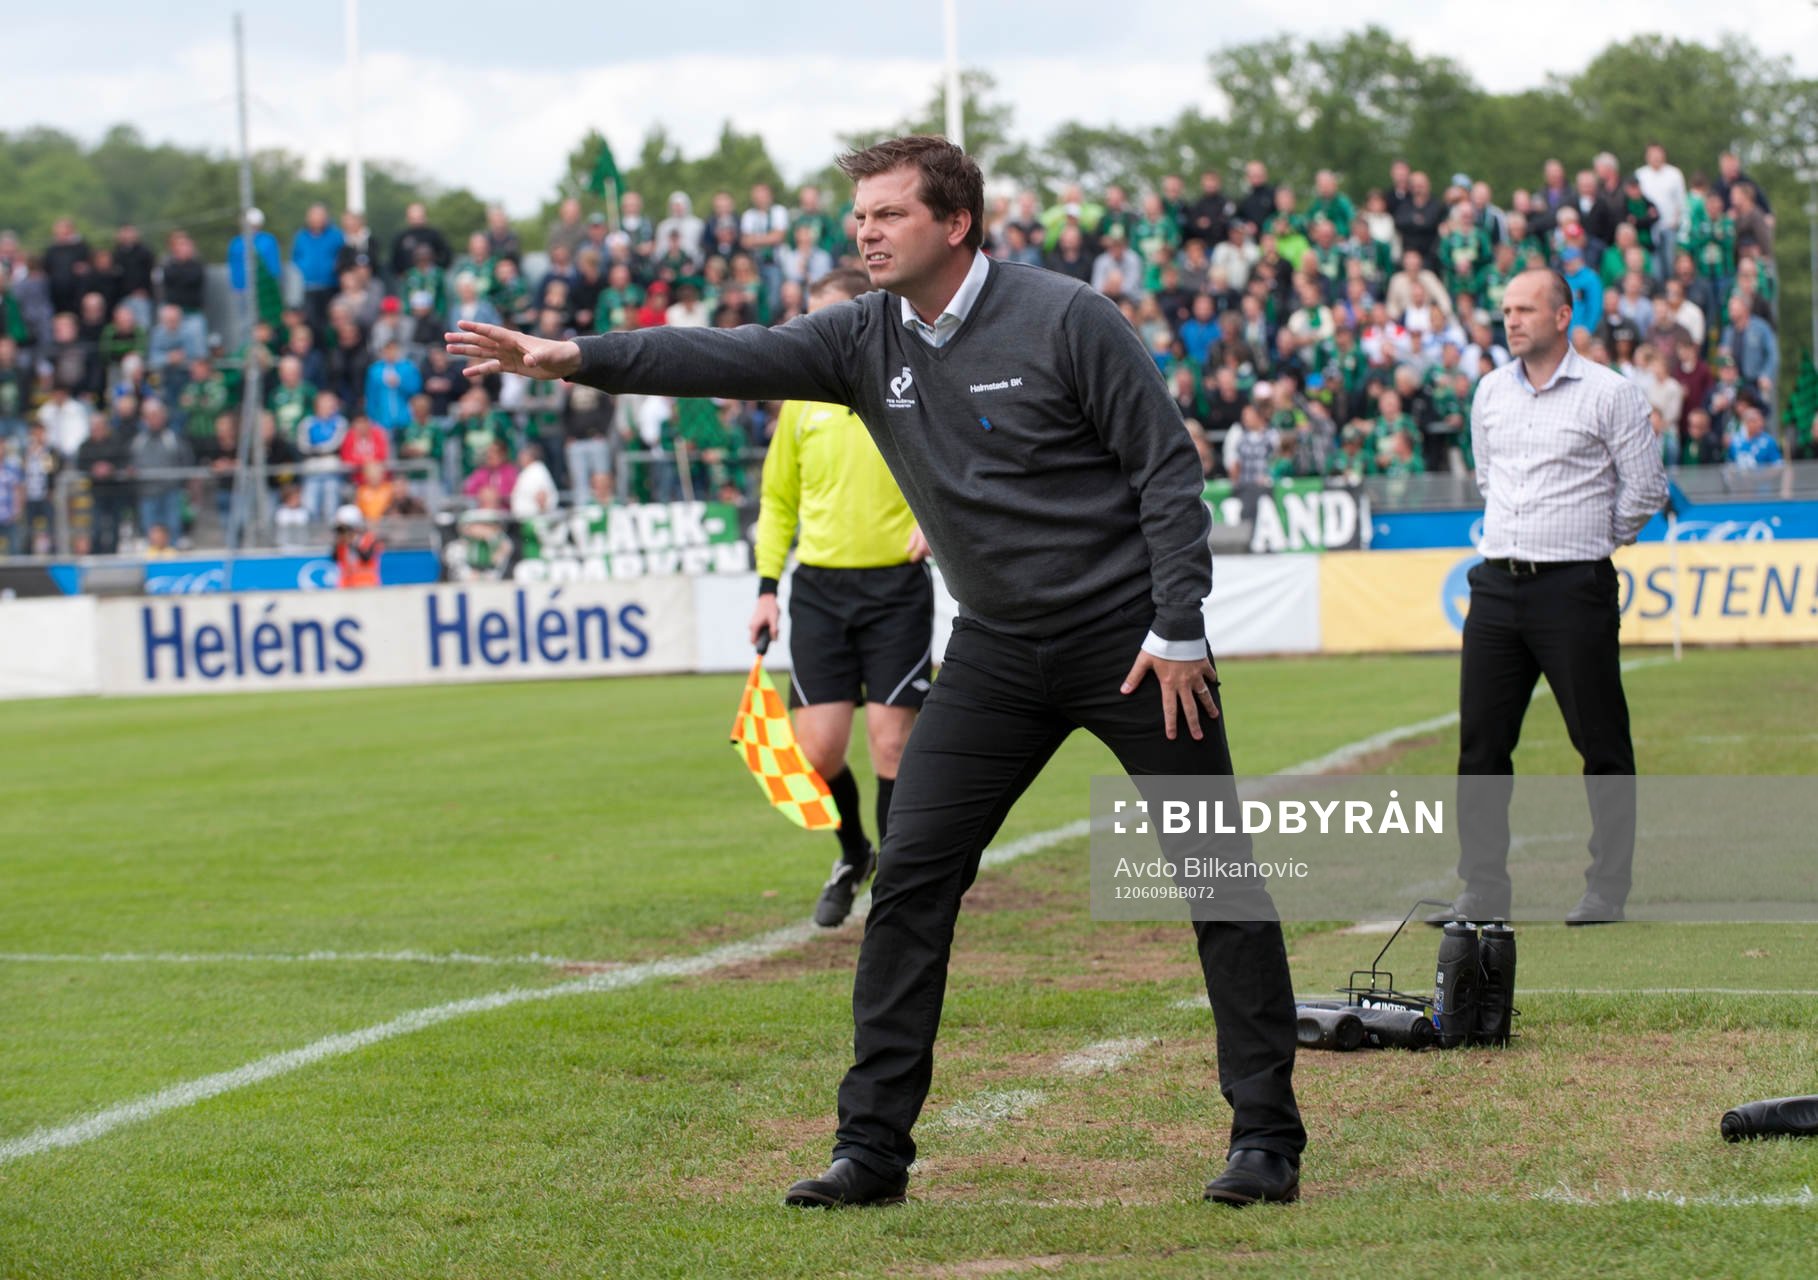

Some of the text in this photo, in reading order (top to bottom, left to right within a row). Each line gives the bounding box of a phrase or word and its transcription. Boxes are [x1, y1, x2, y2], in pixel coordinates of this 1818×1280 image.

[969, 377, 1023, 393] Halmstads BK
[141, 584, 651, 682] Heléns Heléns
